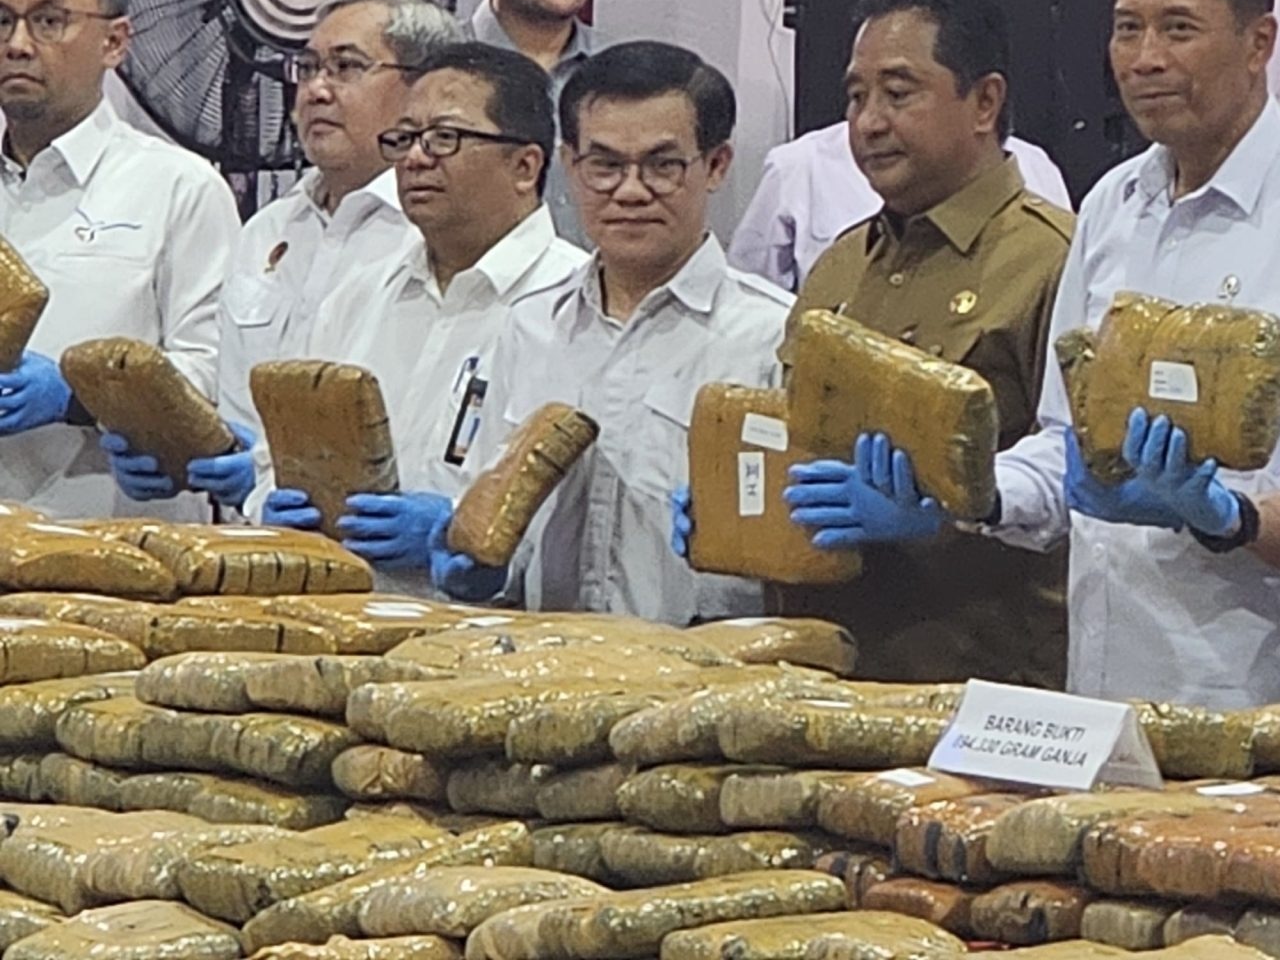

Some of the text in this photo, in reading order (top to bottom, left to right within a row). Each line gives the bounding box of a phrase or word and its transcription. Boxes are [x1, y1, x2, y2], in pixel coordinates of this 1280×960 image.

[985, 715, 1086, 741] BARANG BUKTI
[1000, 741, 1042, 758] GRAM
[1041, 748, 1087, 767] GANJA
